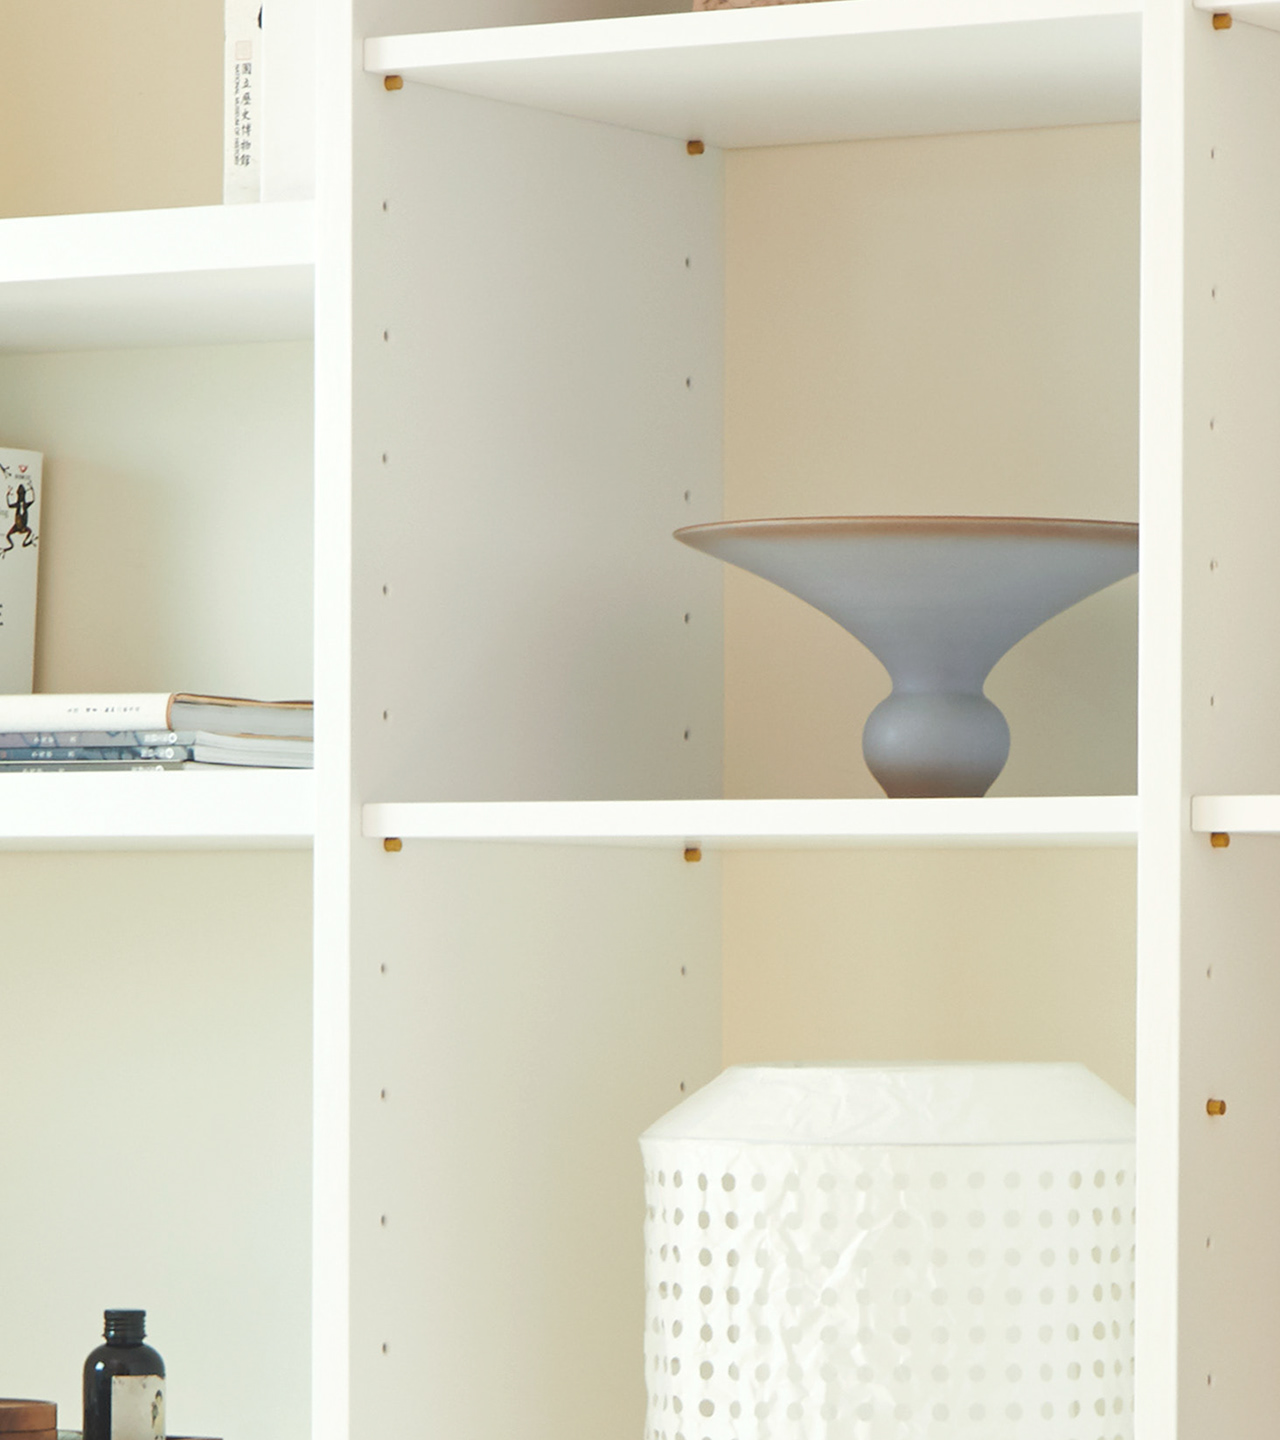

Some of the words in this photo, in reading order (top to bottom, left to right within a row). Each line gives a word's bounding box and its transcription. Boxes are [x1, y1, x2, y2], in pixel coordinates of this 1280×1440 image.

[241, 62, 252, 167] 國立歷史博物館
